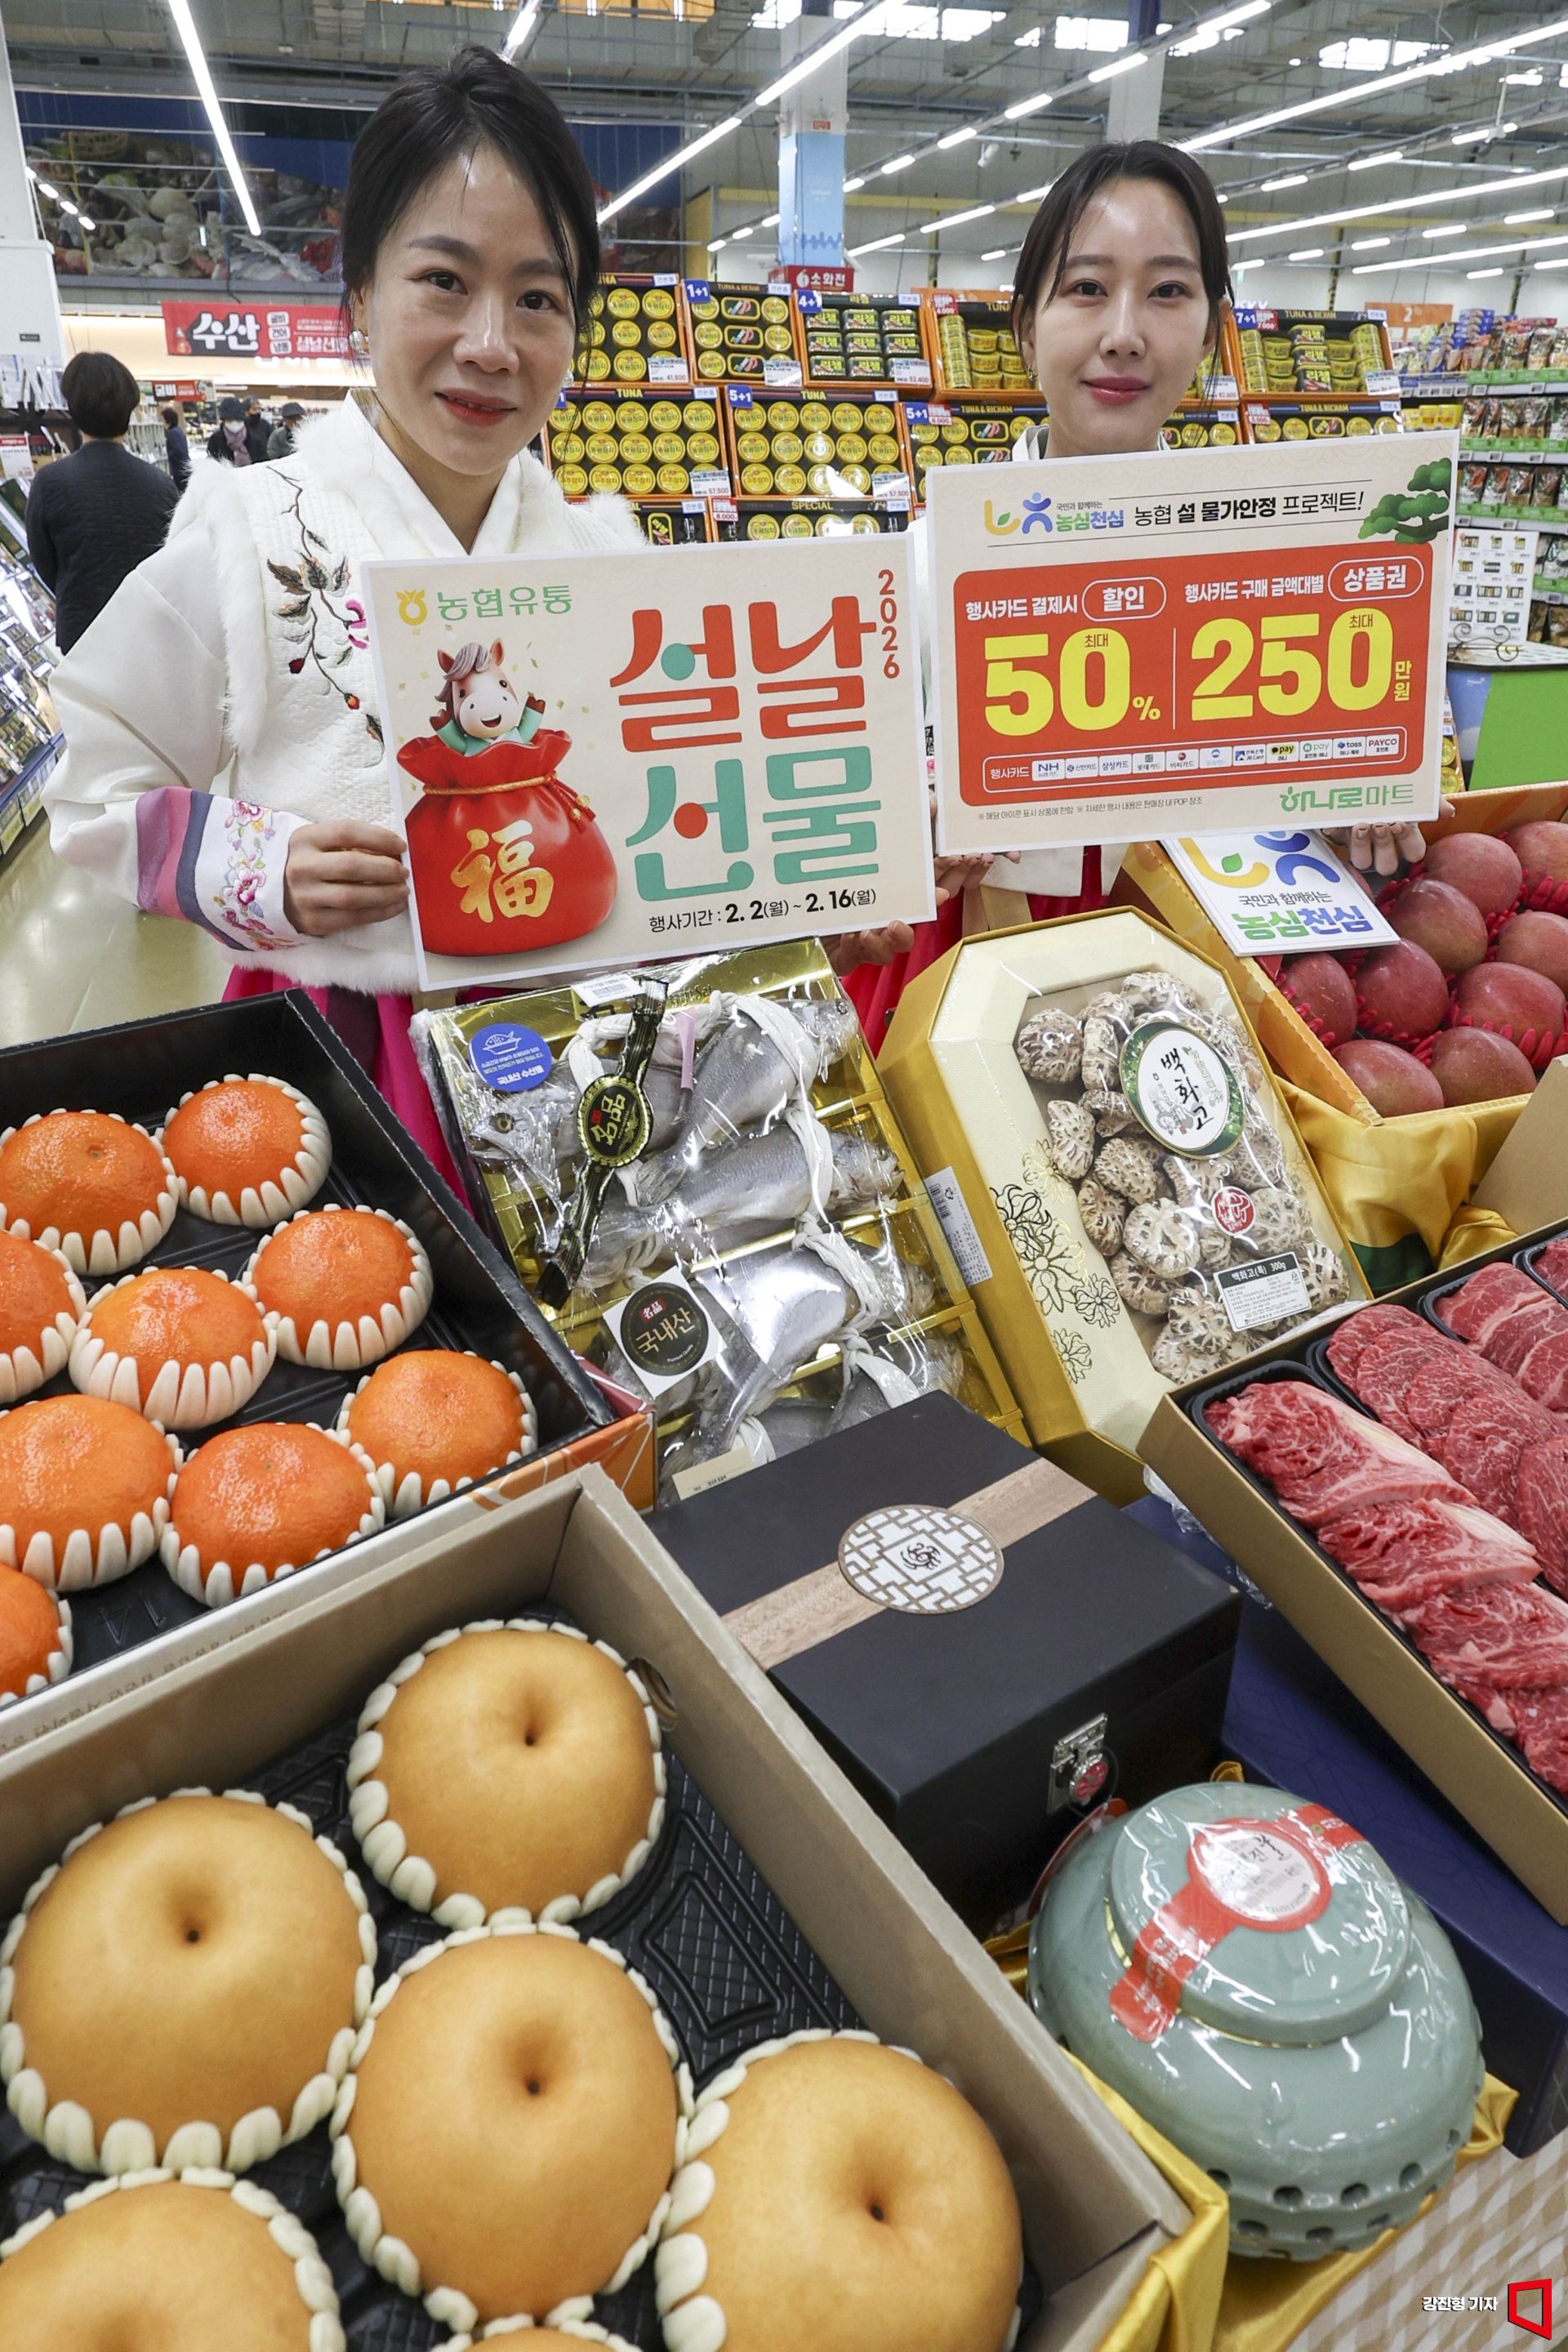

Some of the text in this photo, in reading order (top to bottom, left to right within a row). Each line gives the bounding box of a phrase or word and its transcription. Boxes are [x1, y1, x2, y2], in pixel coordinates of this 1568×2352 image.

[687, 283, 709, 297] 1+1
[811, 273, 845, 287] 소화전
[1236, 312, 1256, 323] 7+1
[193, 313, 261, 350] 수산
[617, 389, 644, 399] TUNA
[729, 389, 751, 402] 5+1
[800, 390, 826, 400] TUNA
[906, 408, 928, 419] 5+1
[960, 405, 979, 413] TUNA
[791, 501, 834, 510] SPECIAL
[1056, 500, 1103, 511] 국민과 함께하는
[1134, 491, 1365, 527] 농협 설 물가안정 프로젝트!
[1056, 510, 1125, 532] 농심천심
[1343, 564, 1407, 593] 상품권
[1102, 586, 1145, 612] 할인
[1184, 574, 1325, 604] 행사카드 구매 금액대별
[437, 585, 572, 621] 농협유통
[965, 595, 1078, 621] 행사카드 결제시
[878, 568, 900, 679] 2026
[1348, 613, 1374, 630] 최대
[1085, 633, 1109, 648] 최대
[609, 595, 877, 753] 설날
[1191, 607, 1393, 722] 250
[1393, 660, 1412, 702] 만원
[1279, 746, 1294, 754] pay
[1313, 743, 1330, 751] pay
[1369, 738, 1397, 746] PAYCO
[990, 766, 1030, 780] 행사카드
[1038, 763, 1059, 772] NH
[1102, 760, 1129, 771] 삼성카드
[986, 796, 1203, 820] 해당 아이콘 표시 상품에 한함 자세한 행사 내용은 판매장 내 POP 참조
[1280, 784, 1414, 812] 하나로마트
[626, 745, 881, 902] 선물
[451, 819, 555, 924] 福
[1238, 891, 1334, 908] 국민과 함께하는
[648, 909, 713, 933] 행사기간
[1232, 905, 1374, 940] 농심천심
[497, 1064, 545, 1085] 국내산 수산물
[1160, 1048, 1215, 1130] 백화고
[1270, 1260, 1287, 1272] 300g
[642, 1300, 663, 1320] 名品
[635, 1307, 695, 1353] 국내산
